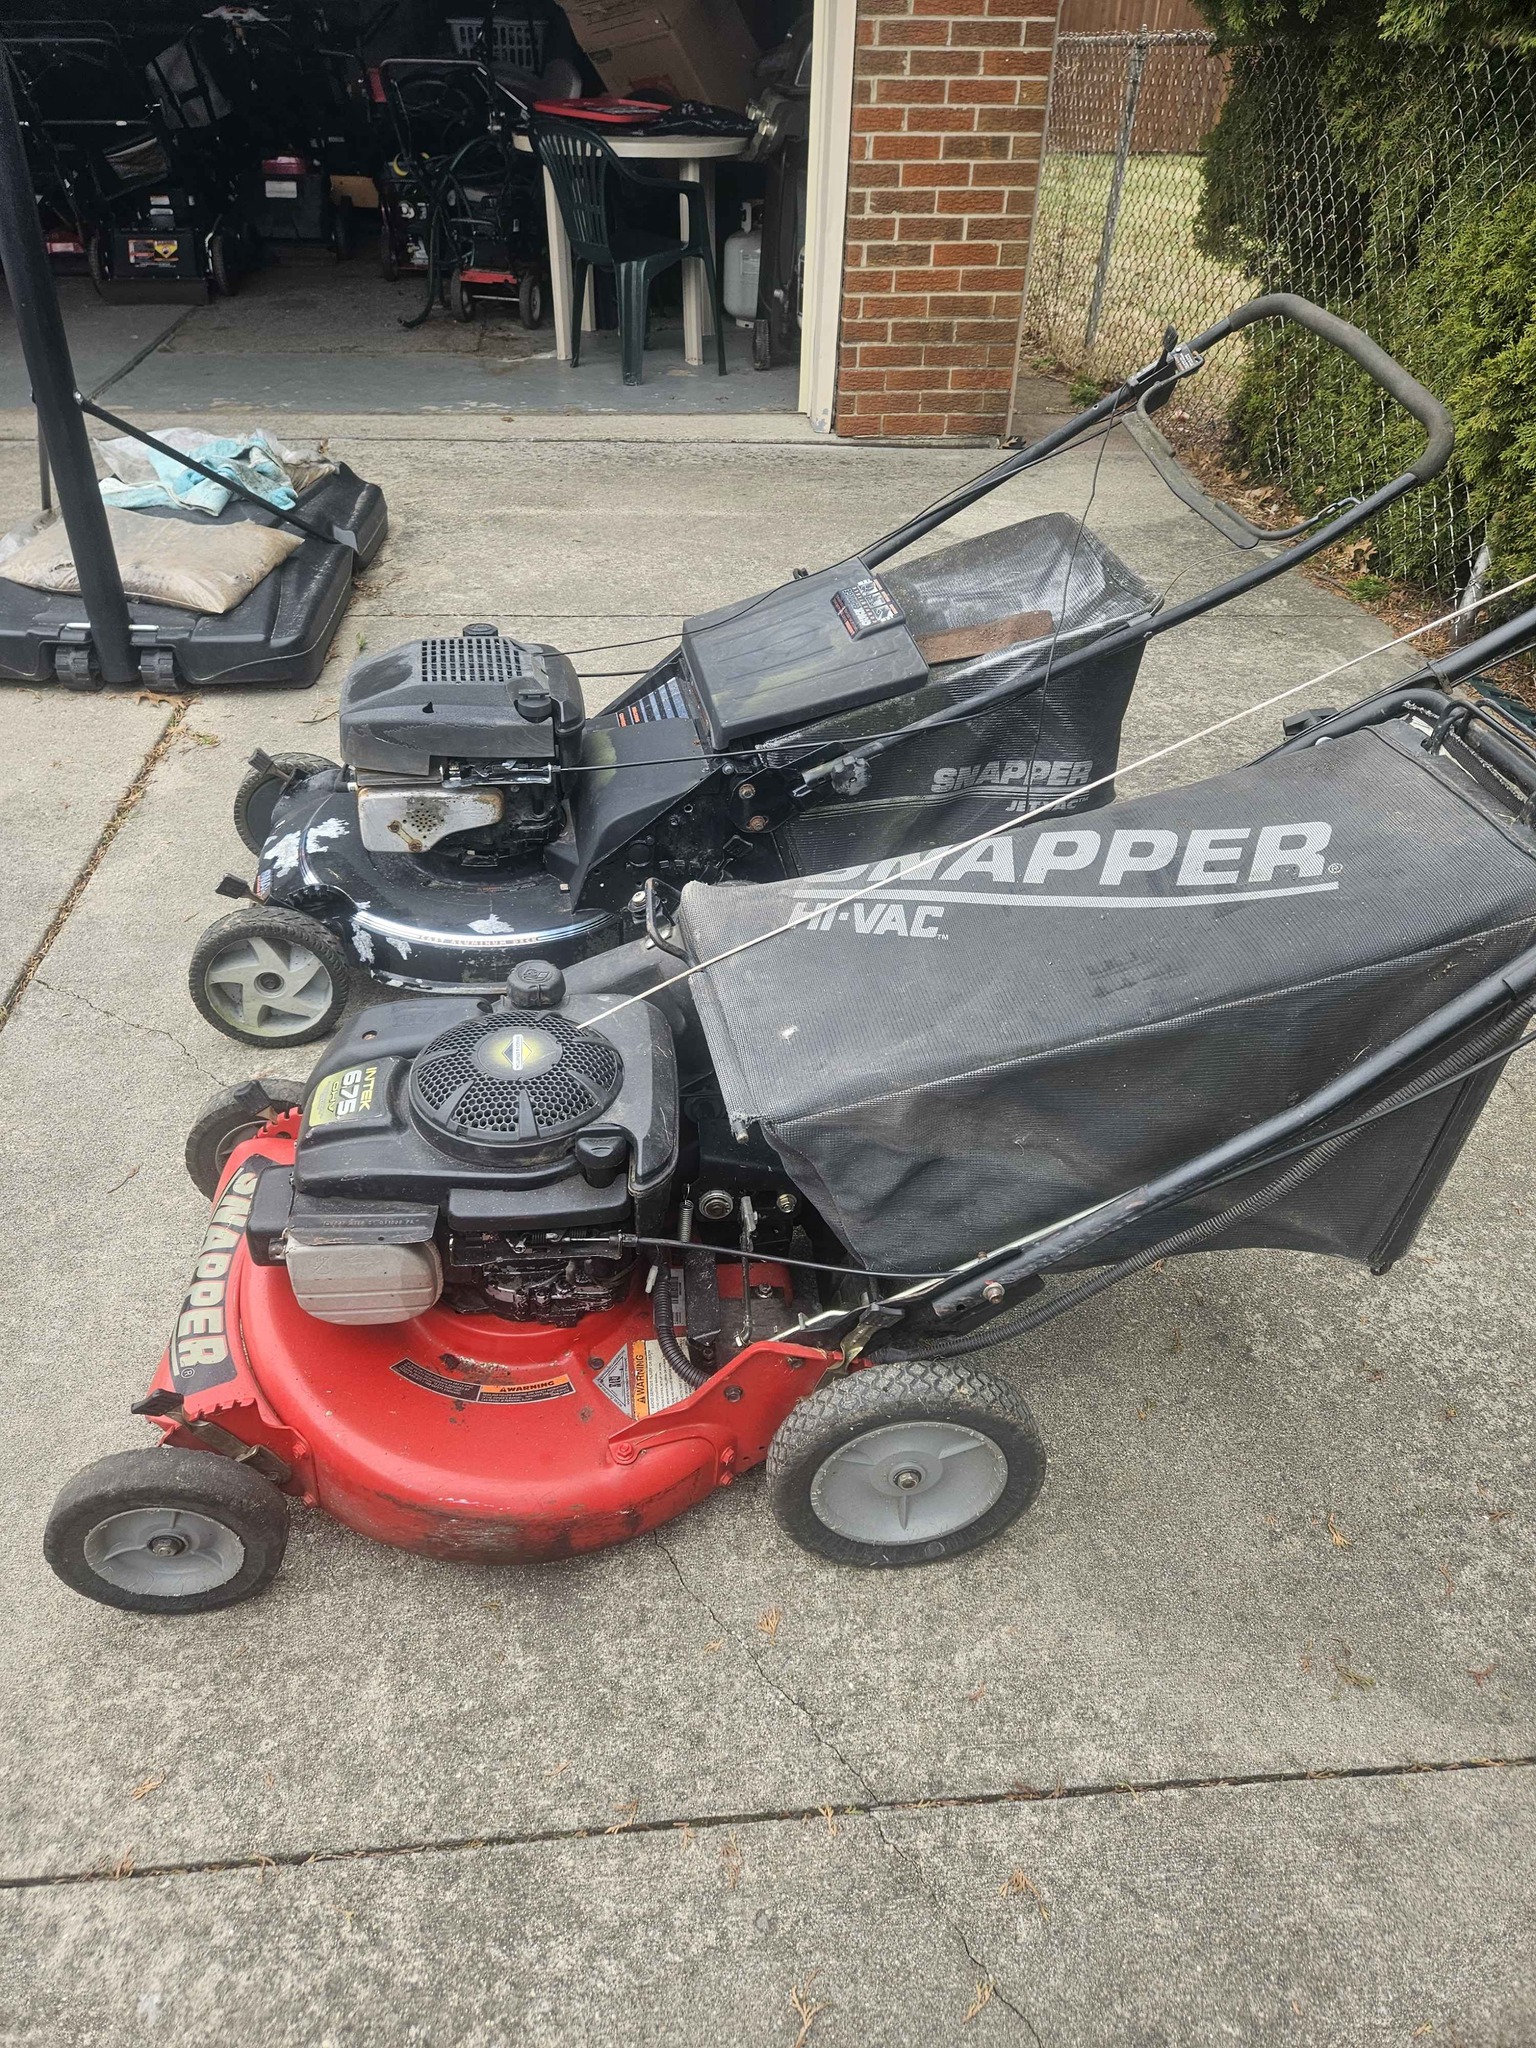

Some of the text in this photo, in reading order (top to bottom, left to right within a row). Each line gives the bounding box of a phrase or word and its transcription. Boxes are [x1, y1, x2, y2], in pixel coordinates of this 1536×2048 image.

[931, 760, 1093, 793] SNAPPER
[788, 902, 945, 938] HI-VAC
[451, 938, 507, 946] ALUMINUM
[328, 1081, 339, 1112] OHV
[359, 1066, 378, 1112] INTEK
[178, 1172, 258, 1368] SNAPPER
[506, 1381, 555, 1392] WARNING
[635, 1354, 645, 1396] WARNING
